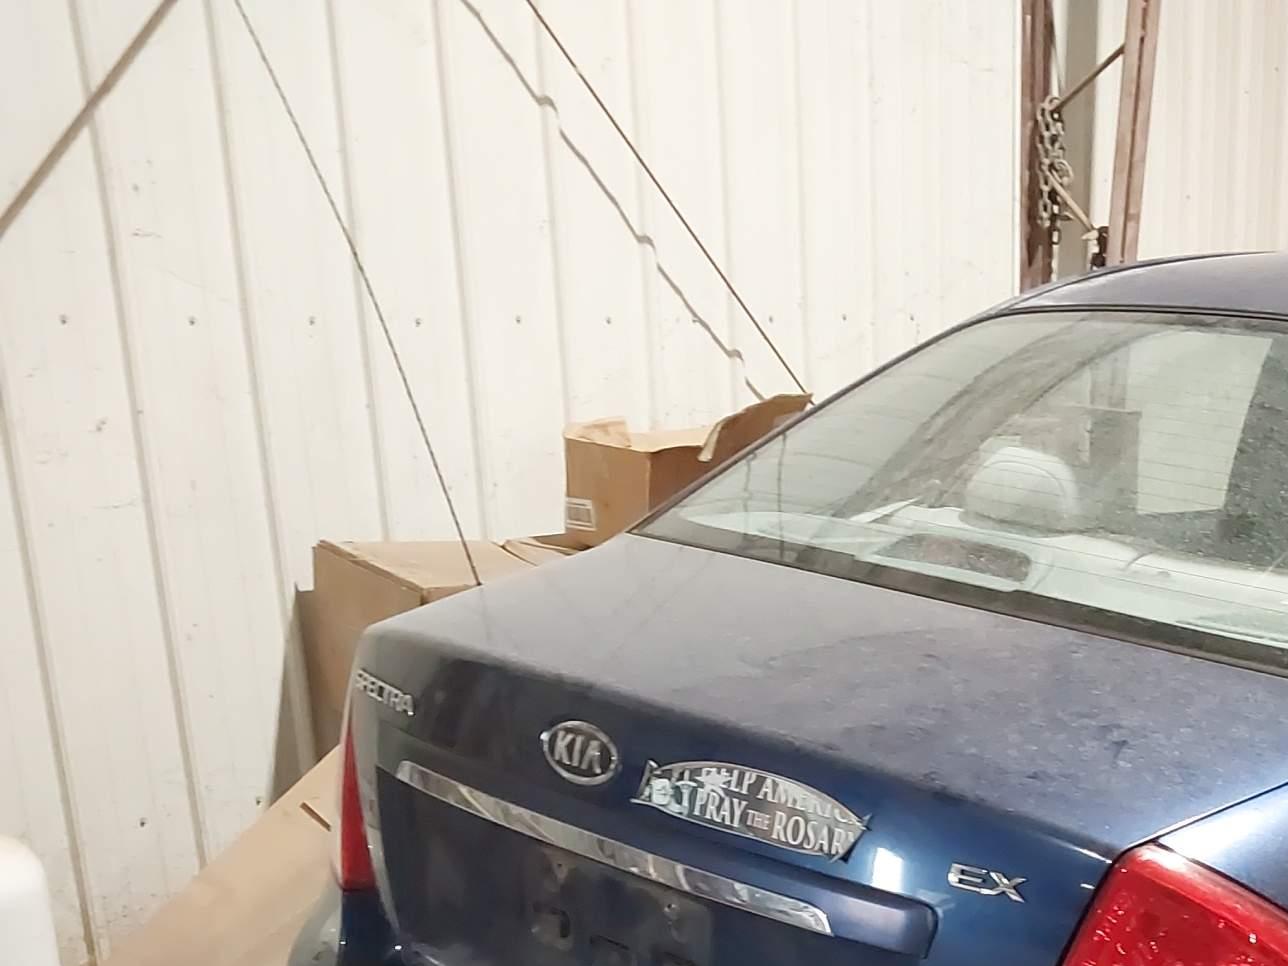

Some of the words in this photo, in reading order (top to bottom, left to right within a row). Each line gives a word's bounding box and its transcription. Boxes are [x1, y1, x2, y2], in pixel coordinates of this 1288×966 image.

[553, 729, 603, 774] KIA
[693, 786, 749, 828] PRAY
[745, 809, 771, 831] THE
[947, 862, 1028, 903] EX
